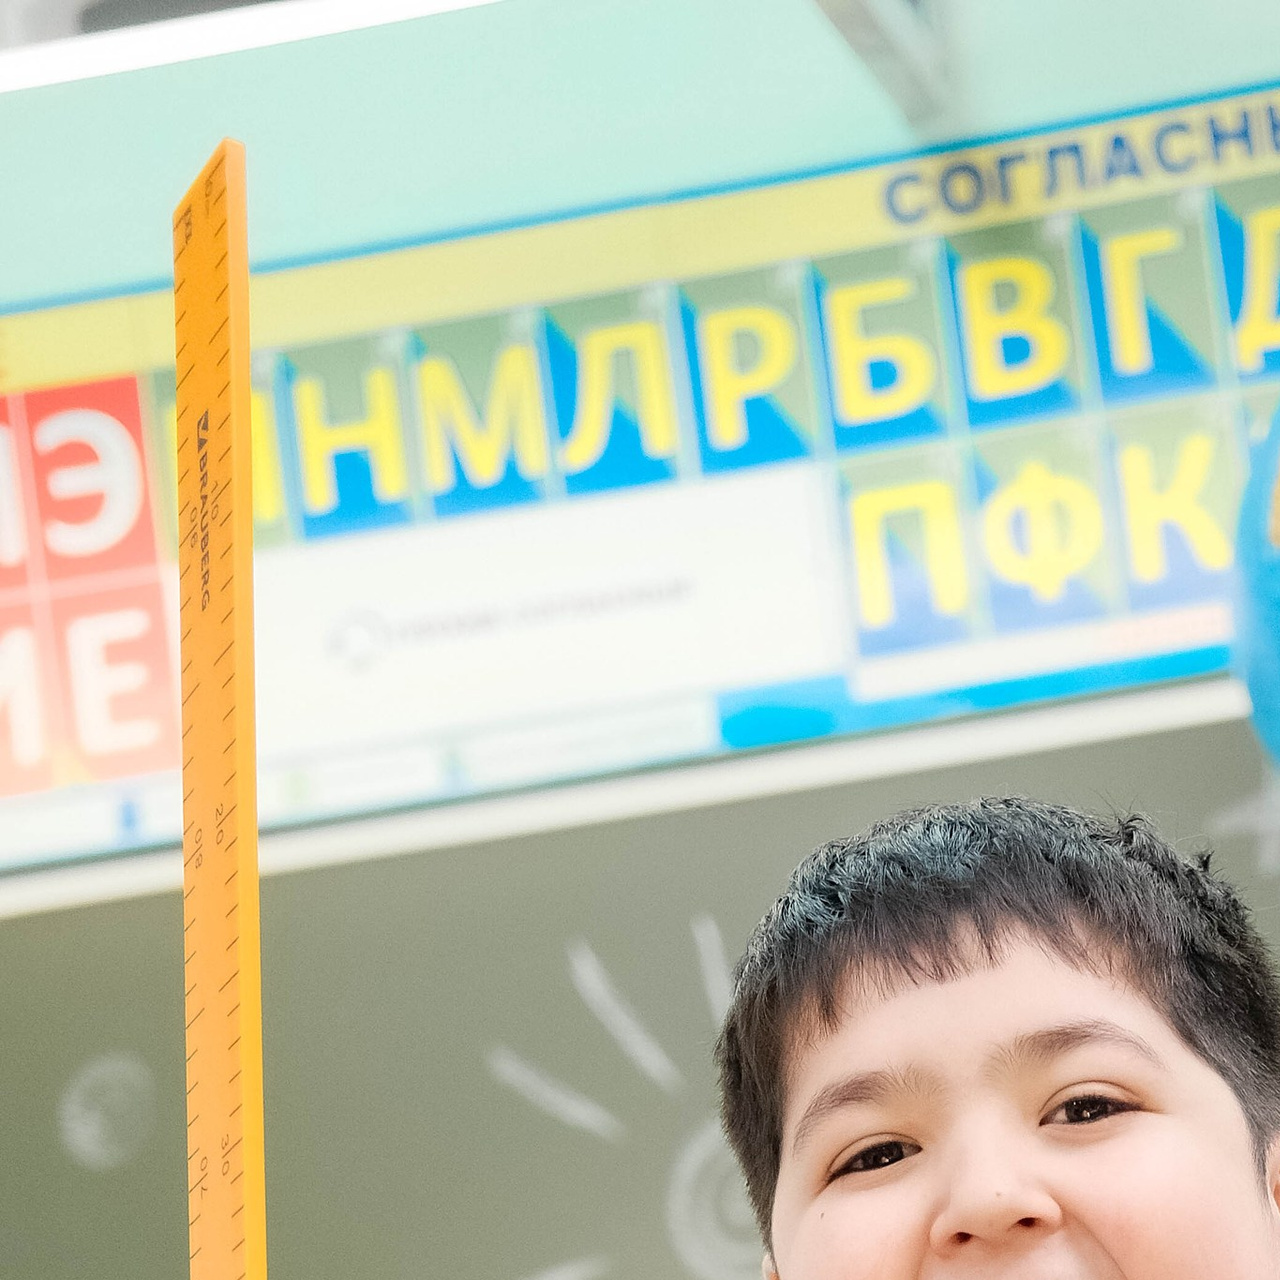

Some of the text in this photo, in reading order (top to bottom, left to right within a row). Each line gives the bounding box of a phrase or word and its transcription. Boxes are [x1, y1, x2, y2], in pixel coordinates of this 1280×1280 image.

[821, 277, 937, 427] Б
[955, 254, 1072, 401] В
[1094, 227, 1181, 376] Г
[199, 450, 210, 611] BRAUBERG
